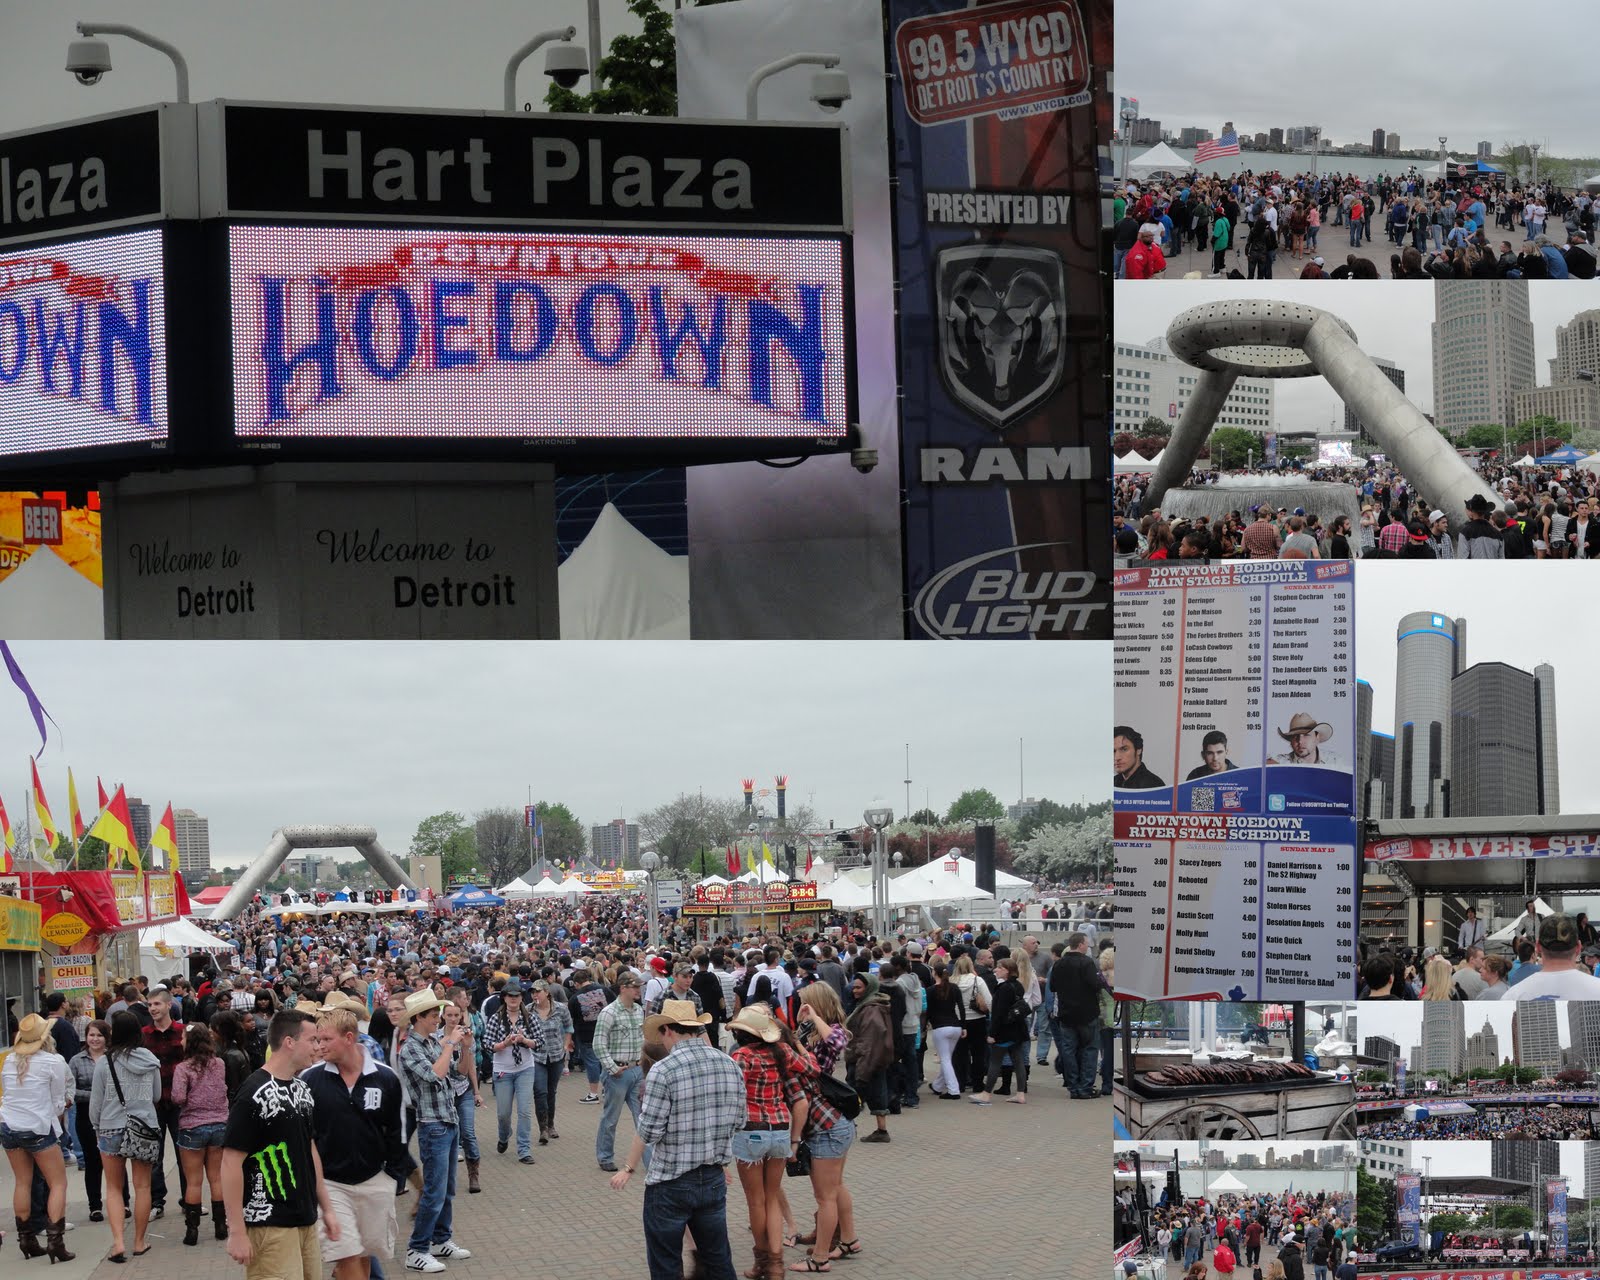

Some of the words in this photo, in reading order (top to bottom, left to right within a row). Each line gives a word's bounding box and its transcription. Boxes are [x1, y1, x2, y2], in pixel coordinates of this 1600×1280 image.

[908, 30, 976, 80] 99.5
[979, 12, 1072, 66] WYCD
[916, 70, 997, 111] DETROIT'S
[999, 55, 1076, 94] COUNTRY
[1000, 94, 1090, 118] WWW.WYCD.COM
[307, 129, 492, 204] Hart
[531, 136, 754, 210] Plaza
[927, 193, 1040, 224] PRESENTED
[1042, 196, 1070, 224] BY
[257, 274, 827, 425] HOEDOWN
[920, 447, 1091, 482] RAM
[24, 506, 58, 539] BEER
[130, 538, 215, 576] Welcome
[222, 544, 241, 568] to
[316, 528, 454, 564] Welcome
[465, 538, 496, 562] to
[1148, 577, 1184, 588] MAIN
[1186, 576, 1230, 586] STAGE
[1232, 572, 1308, 584] SCHEDULE
[1151, 565, 1231, 577] DOWNTOWN
[1234, 561, 1304, 574] HOEDOWN
[394, 574, 515, 608] Detroit
[965, 570, 1096, 601] BUD
[178, 580, 254, 618] Detroit
[939, 602, 1108, 634] LIGHT
[1136, 815, 1224, 827] DOWNTOWN
[1226, 816, 1303, 828] HOEDOWN
[1129, 827, 1176, 838] RIVER
[1179, 828, 1226, 840] STAGE
[1229, 829, 1310, 842] SCHEDULE
[1430, 836, 1534, 858] RIVER
[1548, 835, 1600, 857] ST
[46, 928, 84, 937] LEMONADE
[1176, 930, 1193, 938] Molly
[53, 957, 71, 966] RANCH
[73, 955, 91, 963] BACON
[1175, 948, 1193, 956] David
[1194, 948, 1215, 956] Shelby
[1266, 952, 1293, 960] Stephen
[55, 980, 71, 988] CHILI
[72, 977, 92, 986] CHEESE
[58, 967, 87, 976] CHILI
[1174, 966, 1204, 974] Longneck
[1206, 968, 1236, 976] Strangler
